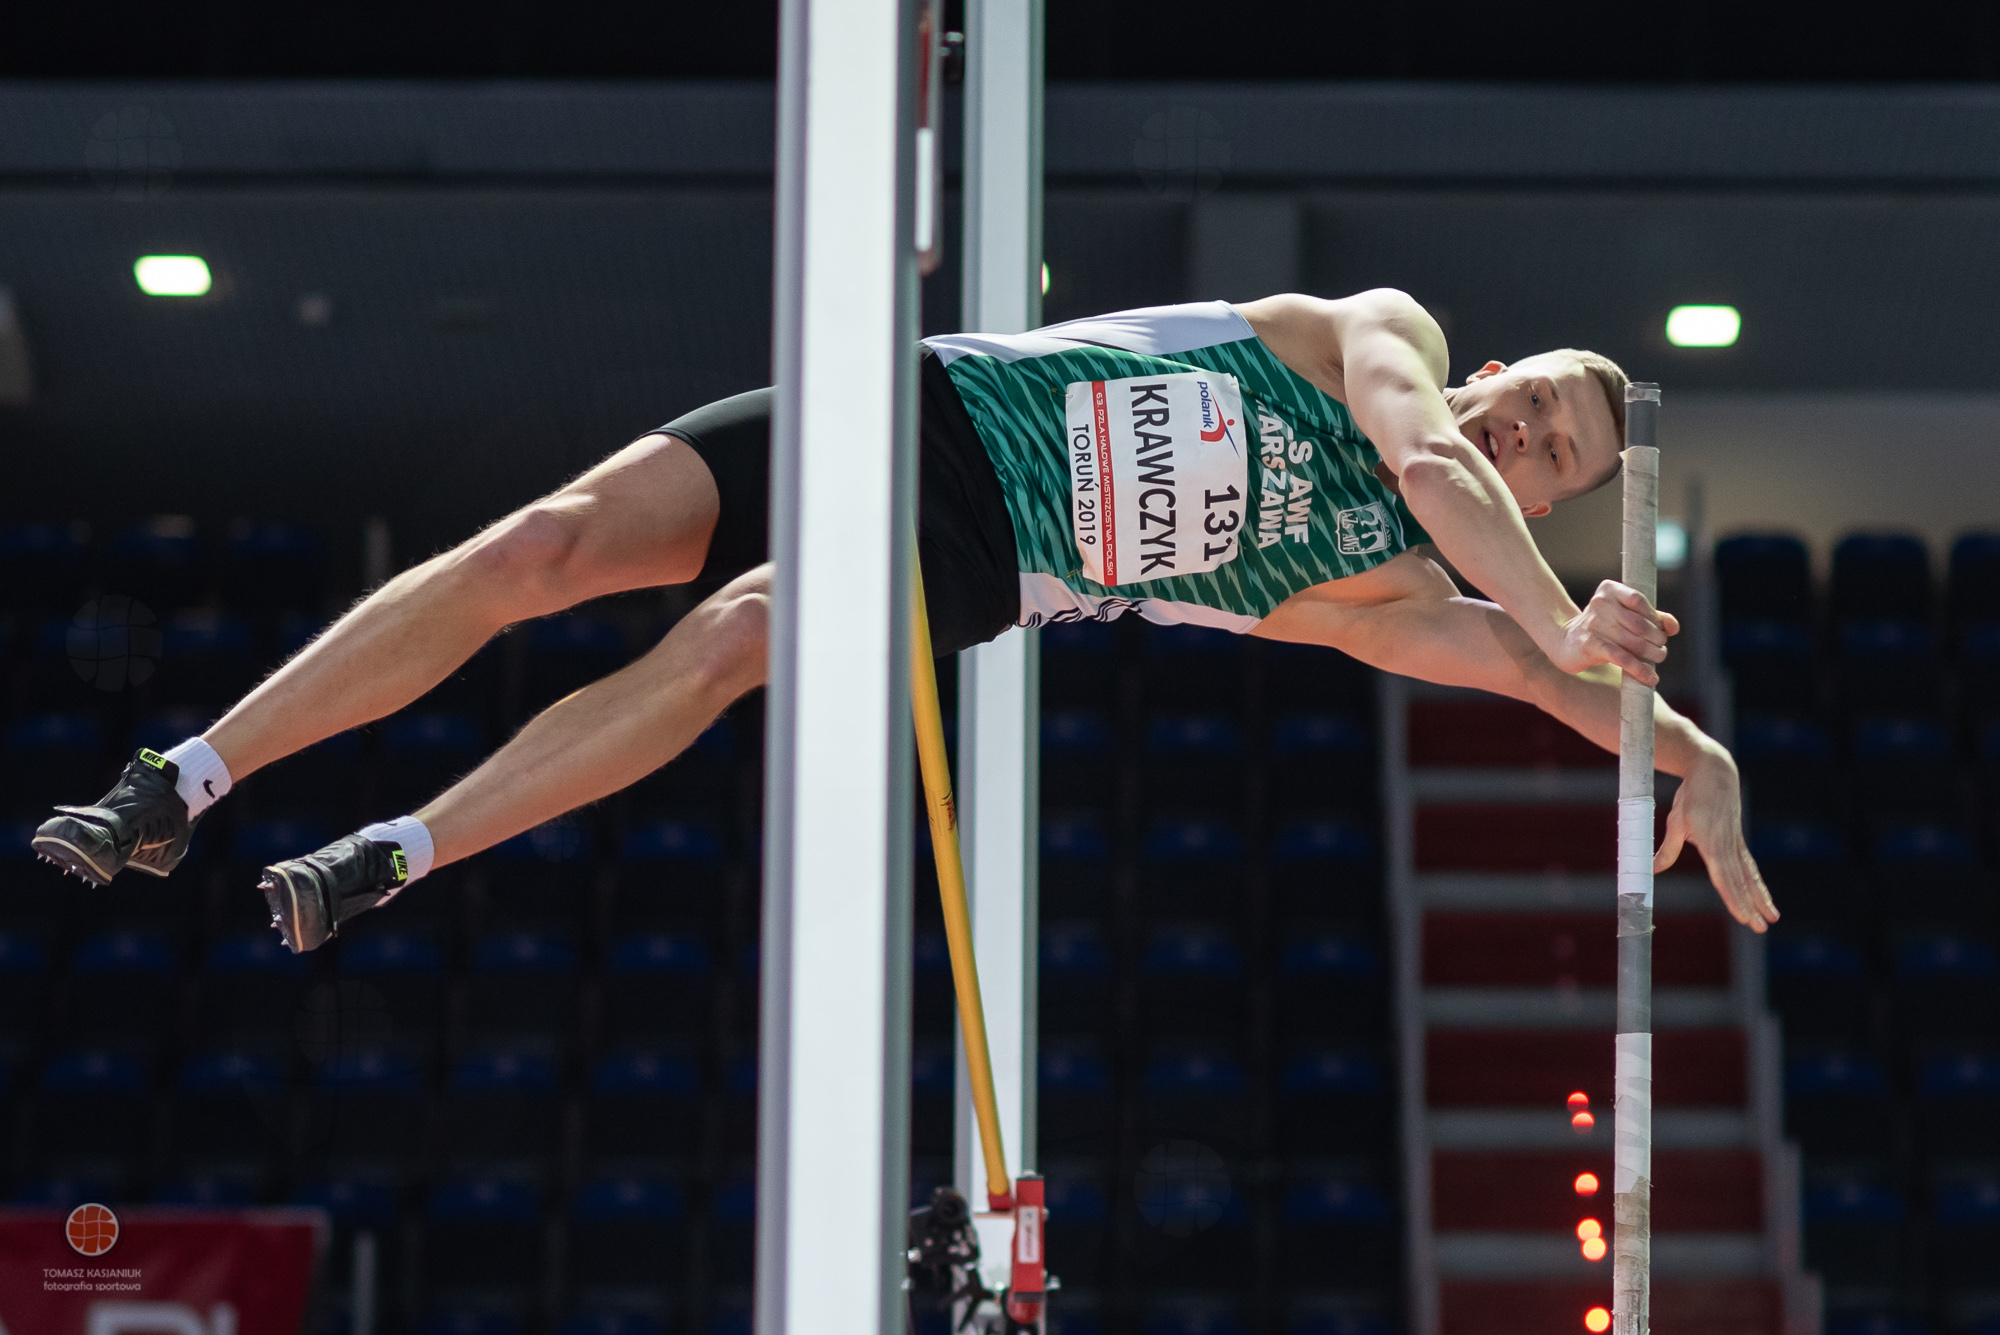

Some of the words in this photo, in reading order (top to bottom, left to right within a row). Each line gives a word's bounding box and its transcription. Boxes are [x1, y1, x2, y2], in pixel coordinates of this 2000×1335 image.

[1097, 409, 1106, 434] PZLA
[1197, 381, 1214, 429] polanik
[1073, 424, 1099, 492] TORUŃ
[1100, 435, 1110, 473] HALOWE
[1130, 384, 1177, 576] KRAWCZYK
[1078, 499, 1097, 545] 2019
[1103, 475, 1113, 543] MISTRZOSTWA
[1203, 484, 1240, 562] 131
[1285, 474, 1313, 544] AWF
[1106, 543, 1114, 576] POLSKI
[142, 751, 165, 765] NIKE
[395, 854, 408, 876] NIKE
